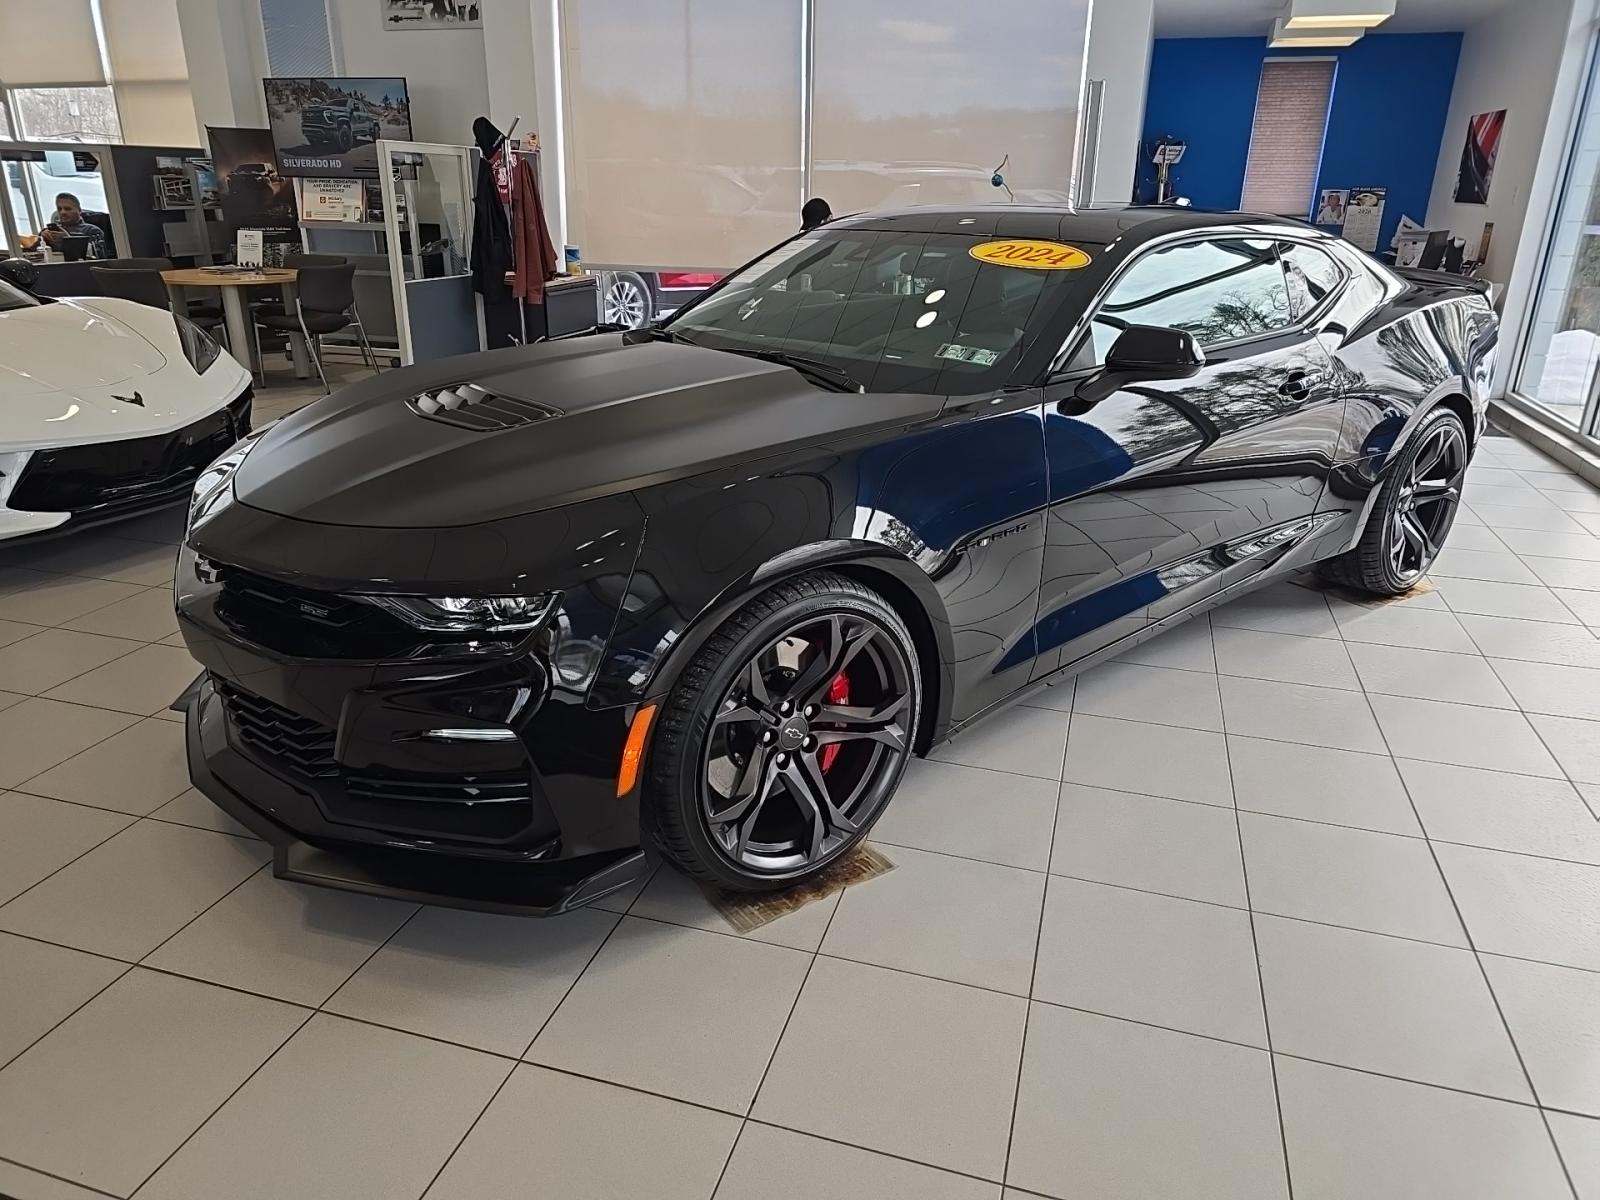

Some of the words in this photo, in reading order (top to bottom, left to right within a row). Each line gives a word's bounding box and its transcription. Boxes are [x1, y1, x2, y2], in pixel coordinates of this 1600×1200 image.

[283, 159, 329, 168] SILVERADO
[329, 160, 342, 168] HD
[984, 244, 1076, 266] 2024
